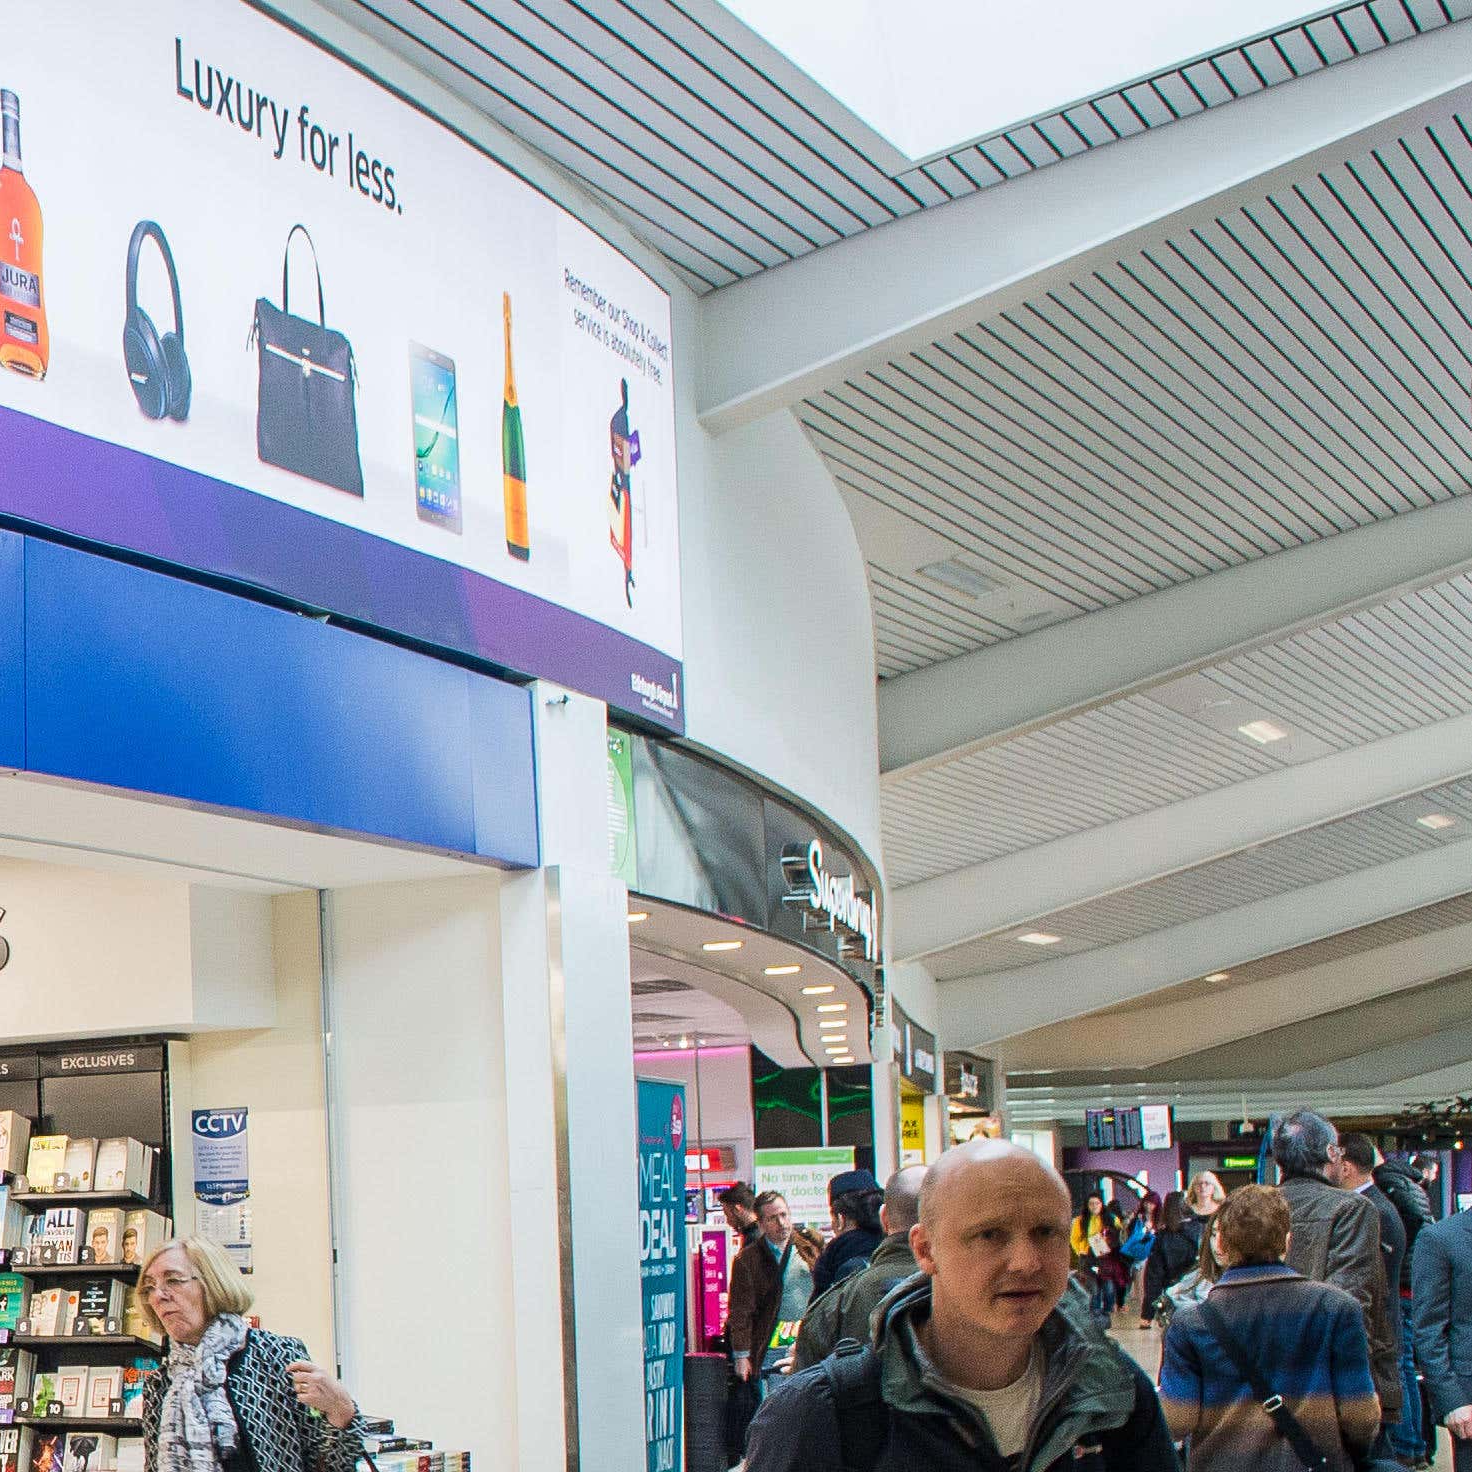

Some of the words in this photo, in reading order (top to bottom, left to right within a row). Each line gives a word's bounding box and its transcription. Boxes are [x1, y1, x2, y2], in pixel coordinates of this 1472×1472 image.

[175, 36, 288, 160] Luxury
[298, 105, 338, 177] for
[348, 132, 402, 216] less.
[2, 268, 37, 294] JURA
[807, 838, 878, 961] Superdrug
[61, 1054, 135, 1070] EXCLUSIVES
[195, 1113, 245, 1133] CCTV
[639, 1152, 678, 1203] MEAL
[761, 1173, 777, 1183] No
[783, 1172, 807, 1182] time
[812, 1170, 823, 1181] to
[48, 1209, 74, 1228] ALL
[640, 1208, 677, 1261] DEAL
[49, 1404, 60, 1414] 10
